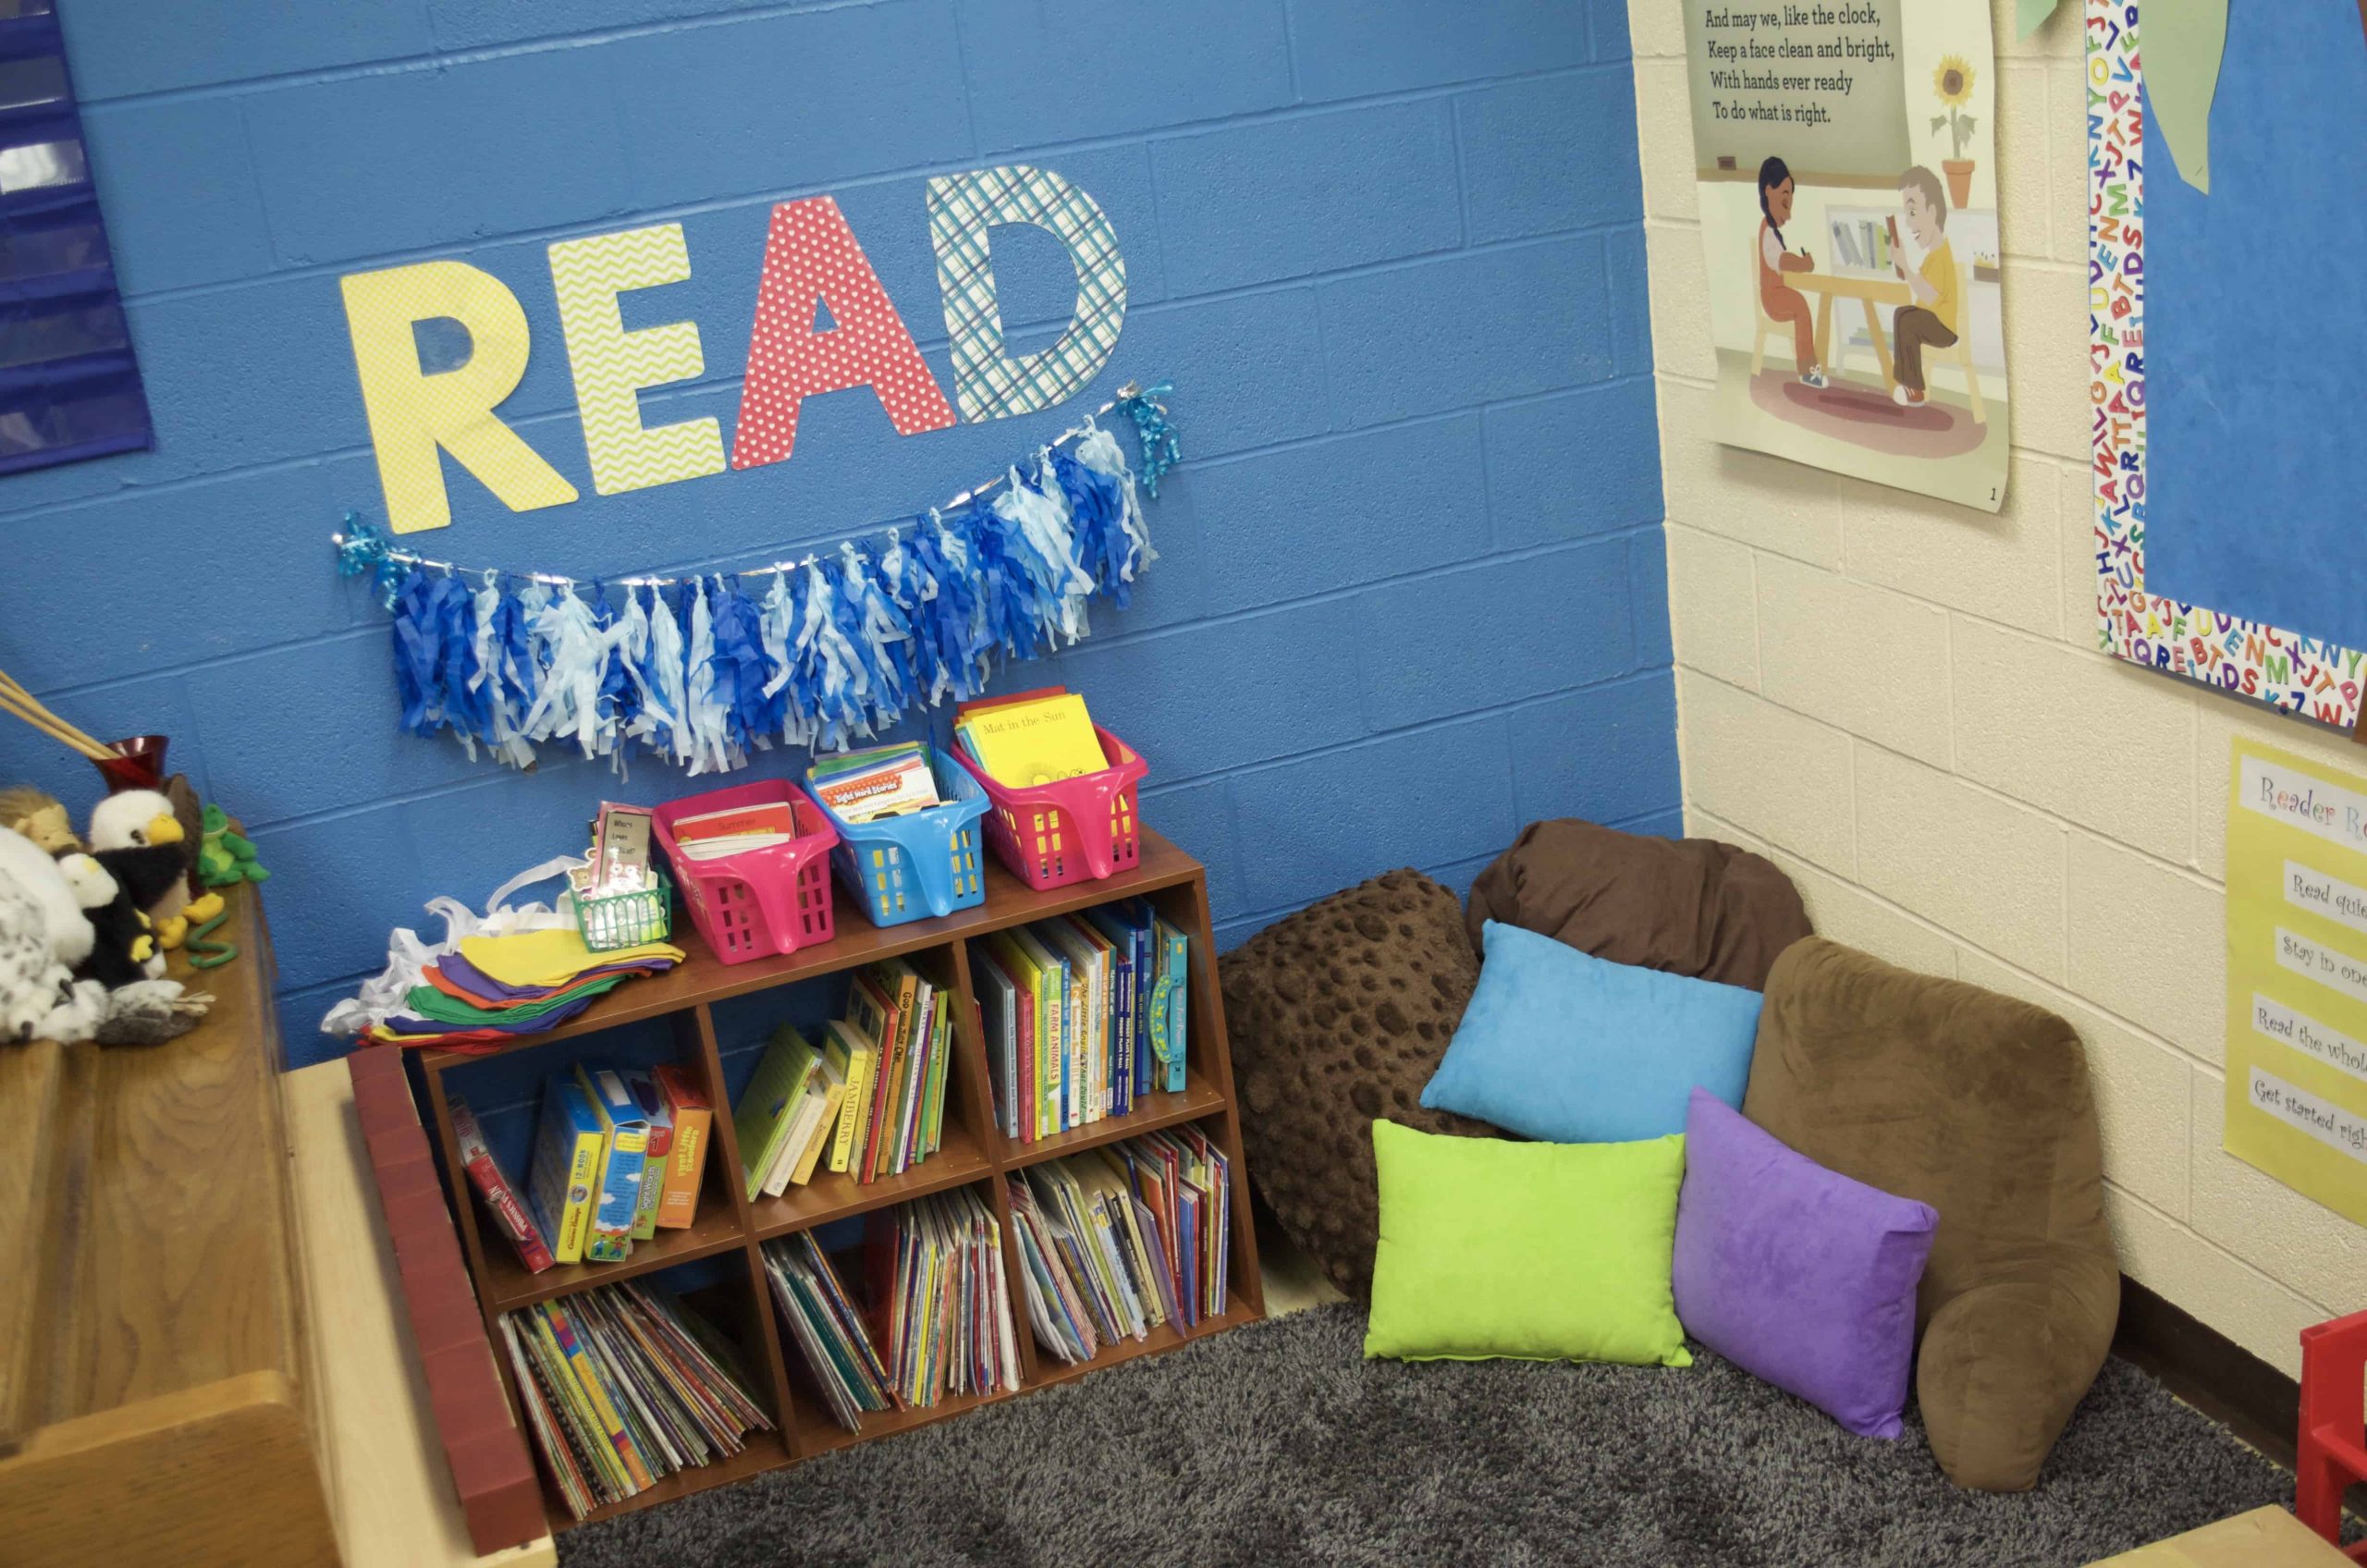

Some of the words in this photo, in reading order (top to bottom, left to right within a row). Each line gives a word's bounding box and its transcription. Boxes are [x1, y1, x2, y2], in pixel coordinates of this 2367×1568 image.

[1706, 8, 1729, 29] And
[1732, 14, 1757, 31] may
[1760, 13, 1781, 31] we,
[1784, 5, 1809, 26] like
[1812, 4, 1834, 25] the
[1838, 2, 1881, 27] clock,
[1708, 41, 1737, 63] Keep
[1740, 45, 1748, 58] a
[1749, 38, 1775, 58] face
[1779, 38, 1813, 58] clean
[1817, 38, 1843, 57] and
[1846, 36, 1895, 62] bright,
[1711, 71, 1741, 90] With
[1744, 70, 1779, 90] hands
[1783, 76, 1809, 91] ever
[1814, 71, 1853, 95] ready
[1712, 101, 1728, 119] To
[1731, 100, 1746, 120] do
[1748, 101, 1779, 121] what
[1781, 104, 1792, 121] is
[1795, 103, 1832, 127] right.
[340, 165, 1127, 534] READ
[983, 724, 1005, 735] Mat
[1008, 717, 1020, 729] in
[1022, 716, 1040, 729] the
[1044, 710, 1066, 723] Sun
[2260, 776, 2336, 826] Reader
[2293, 874, 2330, 903] Read
[2283, 936, 2314, 967] Stay
[2320, 952, 2336, 974] in
[1050, 1004, 1060, 1032] FARM
[2258, 1007, 2293, 1038] Read
[2299, 1026, 2323, 1052] the
[2327, 1043, 2367, 1073] whol
[1050, 1035, 1060, 1081] ANIMALS
[840, 1076, 860, 1146] JAMBERRY
[2254, 1079, 2280, 1106] Get
[2285, 1096, 2335, 1133] started
